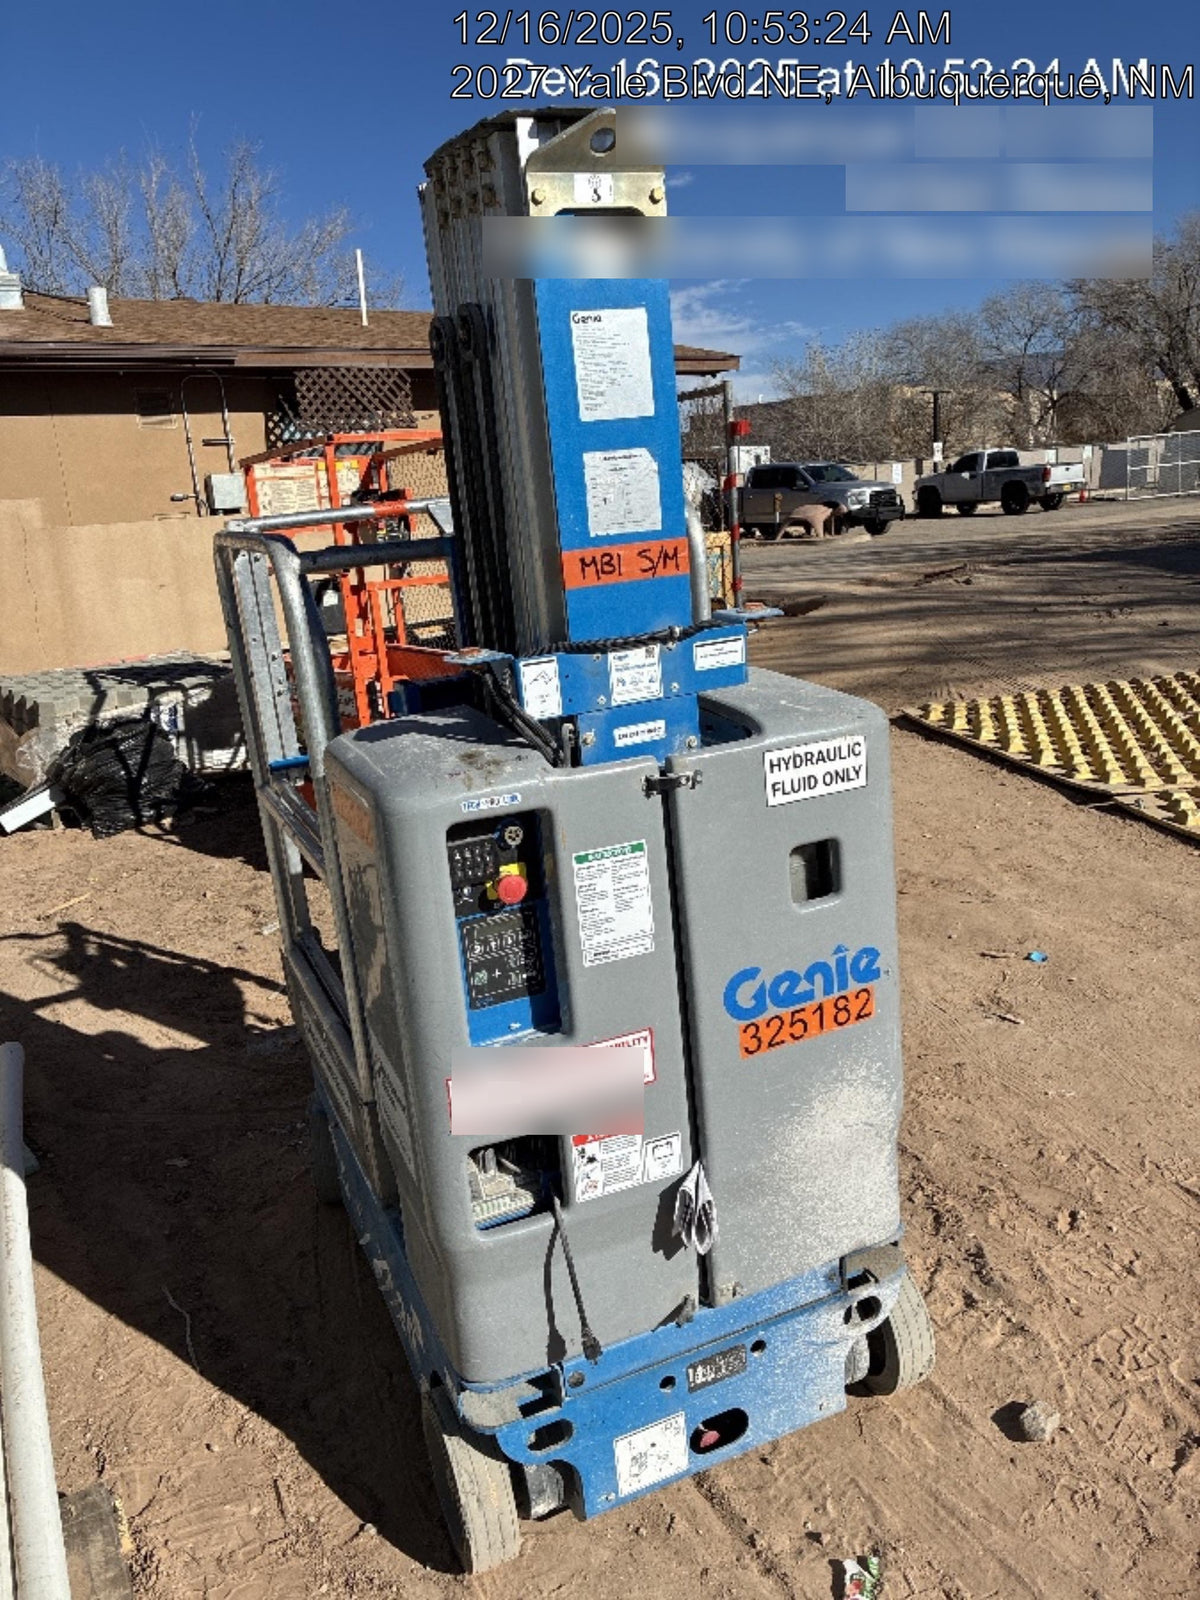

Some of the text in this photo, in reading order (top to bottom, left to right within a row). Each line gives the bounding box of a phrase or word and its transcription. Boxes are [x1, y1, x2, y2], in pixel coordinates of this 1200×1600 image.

[637, 545, 680, 578] S/M
[769, 742, 862, 774] HYDRAULIC
[771, 764, 862, 797] FLUID ONLY
[723, 943, 882, 1021] Genie
[742, 988, 872, 1055] 325182
